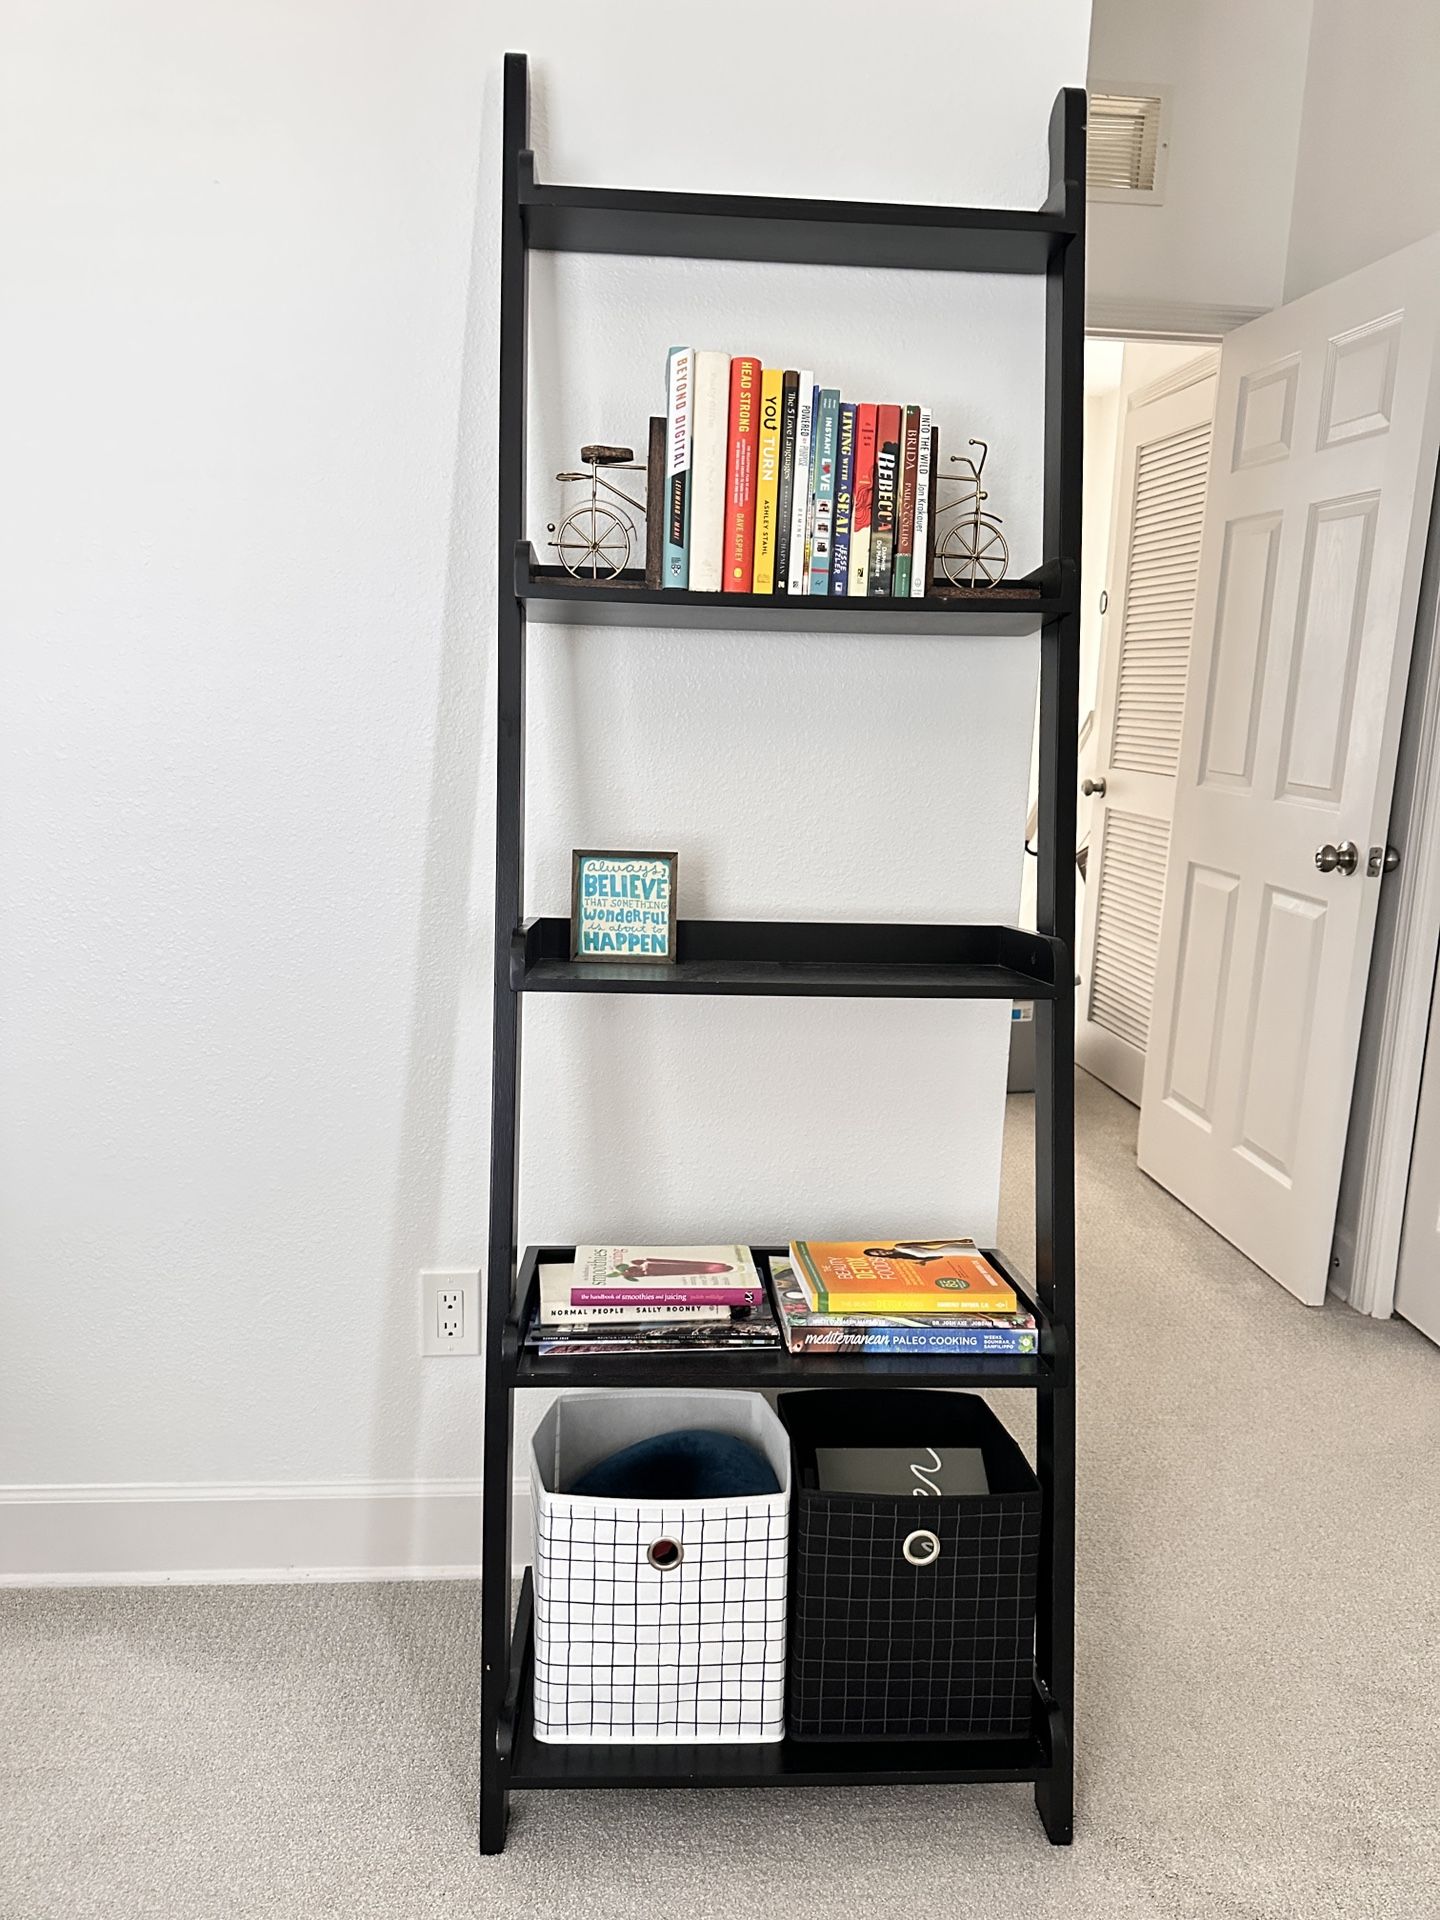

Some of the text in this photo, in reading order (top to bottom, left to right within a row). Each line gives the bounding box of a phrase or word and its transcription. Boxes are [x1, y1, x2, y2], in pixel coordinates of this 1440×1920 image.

[740, 361, 753, 389] HEAD
[673, 357, 688, 468] BEYOND DIGITAL
[738, 391, 752, 432] STRONG
[787, 391, 796, 407] The
[785, 415, 795, 435] Love
[800, 405, 811, 437] POWERED
[840, 411, 853, 456] LIVING
[760, 396, 778, 482] YOU TURN
[823, 416, 833, 455] INSTANT
[905, 429, 917, 470] BRIDA
[919, 414, 930, 475] INTO THE WILD
[783, 437, 794, 481] Languages
[674, 479, 682, 514] LEINWAND
[877, 451, 896, 531] REBECCA
[902, 482, 911, 510] PAULO
[735, 513, 745, 531] DAVE
[835, 492, 851, 537] SEAL
[916, 483, 927, 533] Jon Krakauer
[673, 521, 681, 540] MANI
[761, 532, 769, 556] STAHL
[734, 533, 744, 562] ASPREY
[779, 537, 788, 575] CHAPMAN
[833, 544, 842, 574] ITZLER
[840, 544, 848, 572] JESSE
[584, 874, 667, 900] BELIEVE
[584, 898, 668, 909] THAT SOMETHING
[583, 931, 667, 953] HAPPEN
[588, 922, 606, 931] is
[609, 924, 647, 934] about
[589, 1248, 608, 1286] smoothies
[828, 1256, 854, 1281] BEAUTY
[845, 1256, 877, 1280] DETOX
[869, 1256, 897, 1280] FOODS
[551, 1308, 588, 1316] NORMAL
[592, 1307, 624, 1315] PEOPLE
[666, 1305, 702, 1313] ROONEY
[621, 1293, 655, 1301] smoothies
[664, 1293, 687, 1302] juicing
[805, 1331, 977, 1346] mediterranean PALEO COOKING
